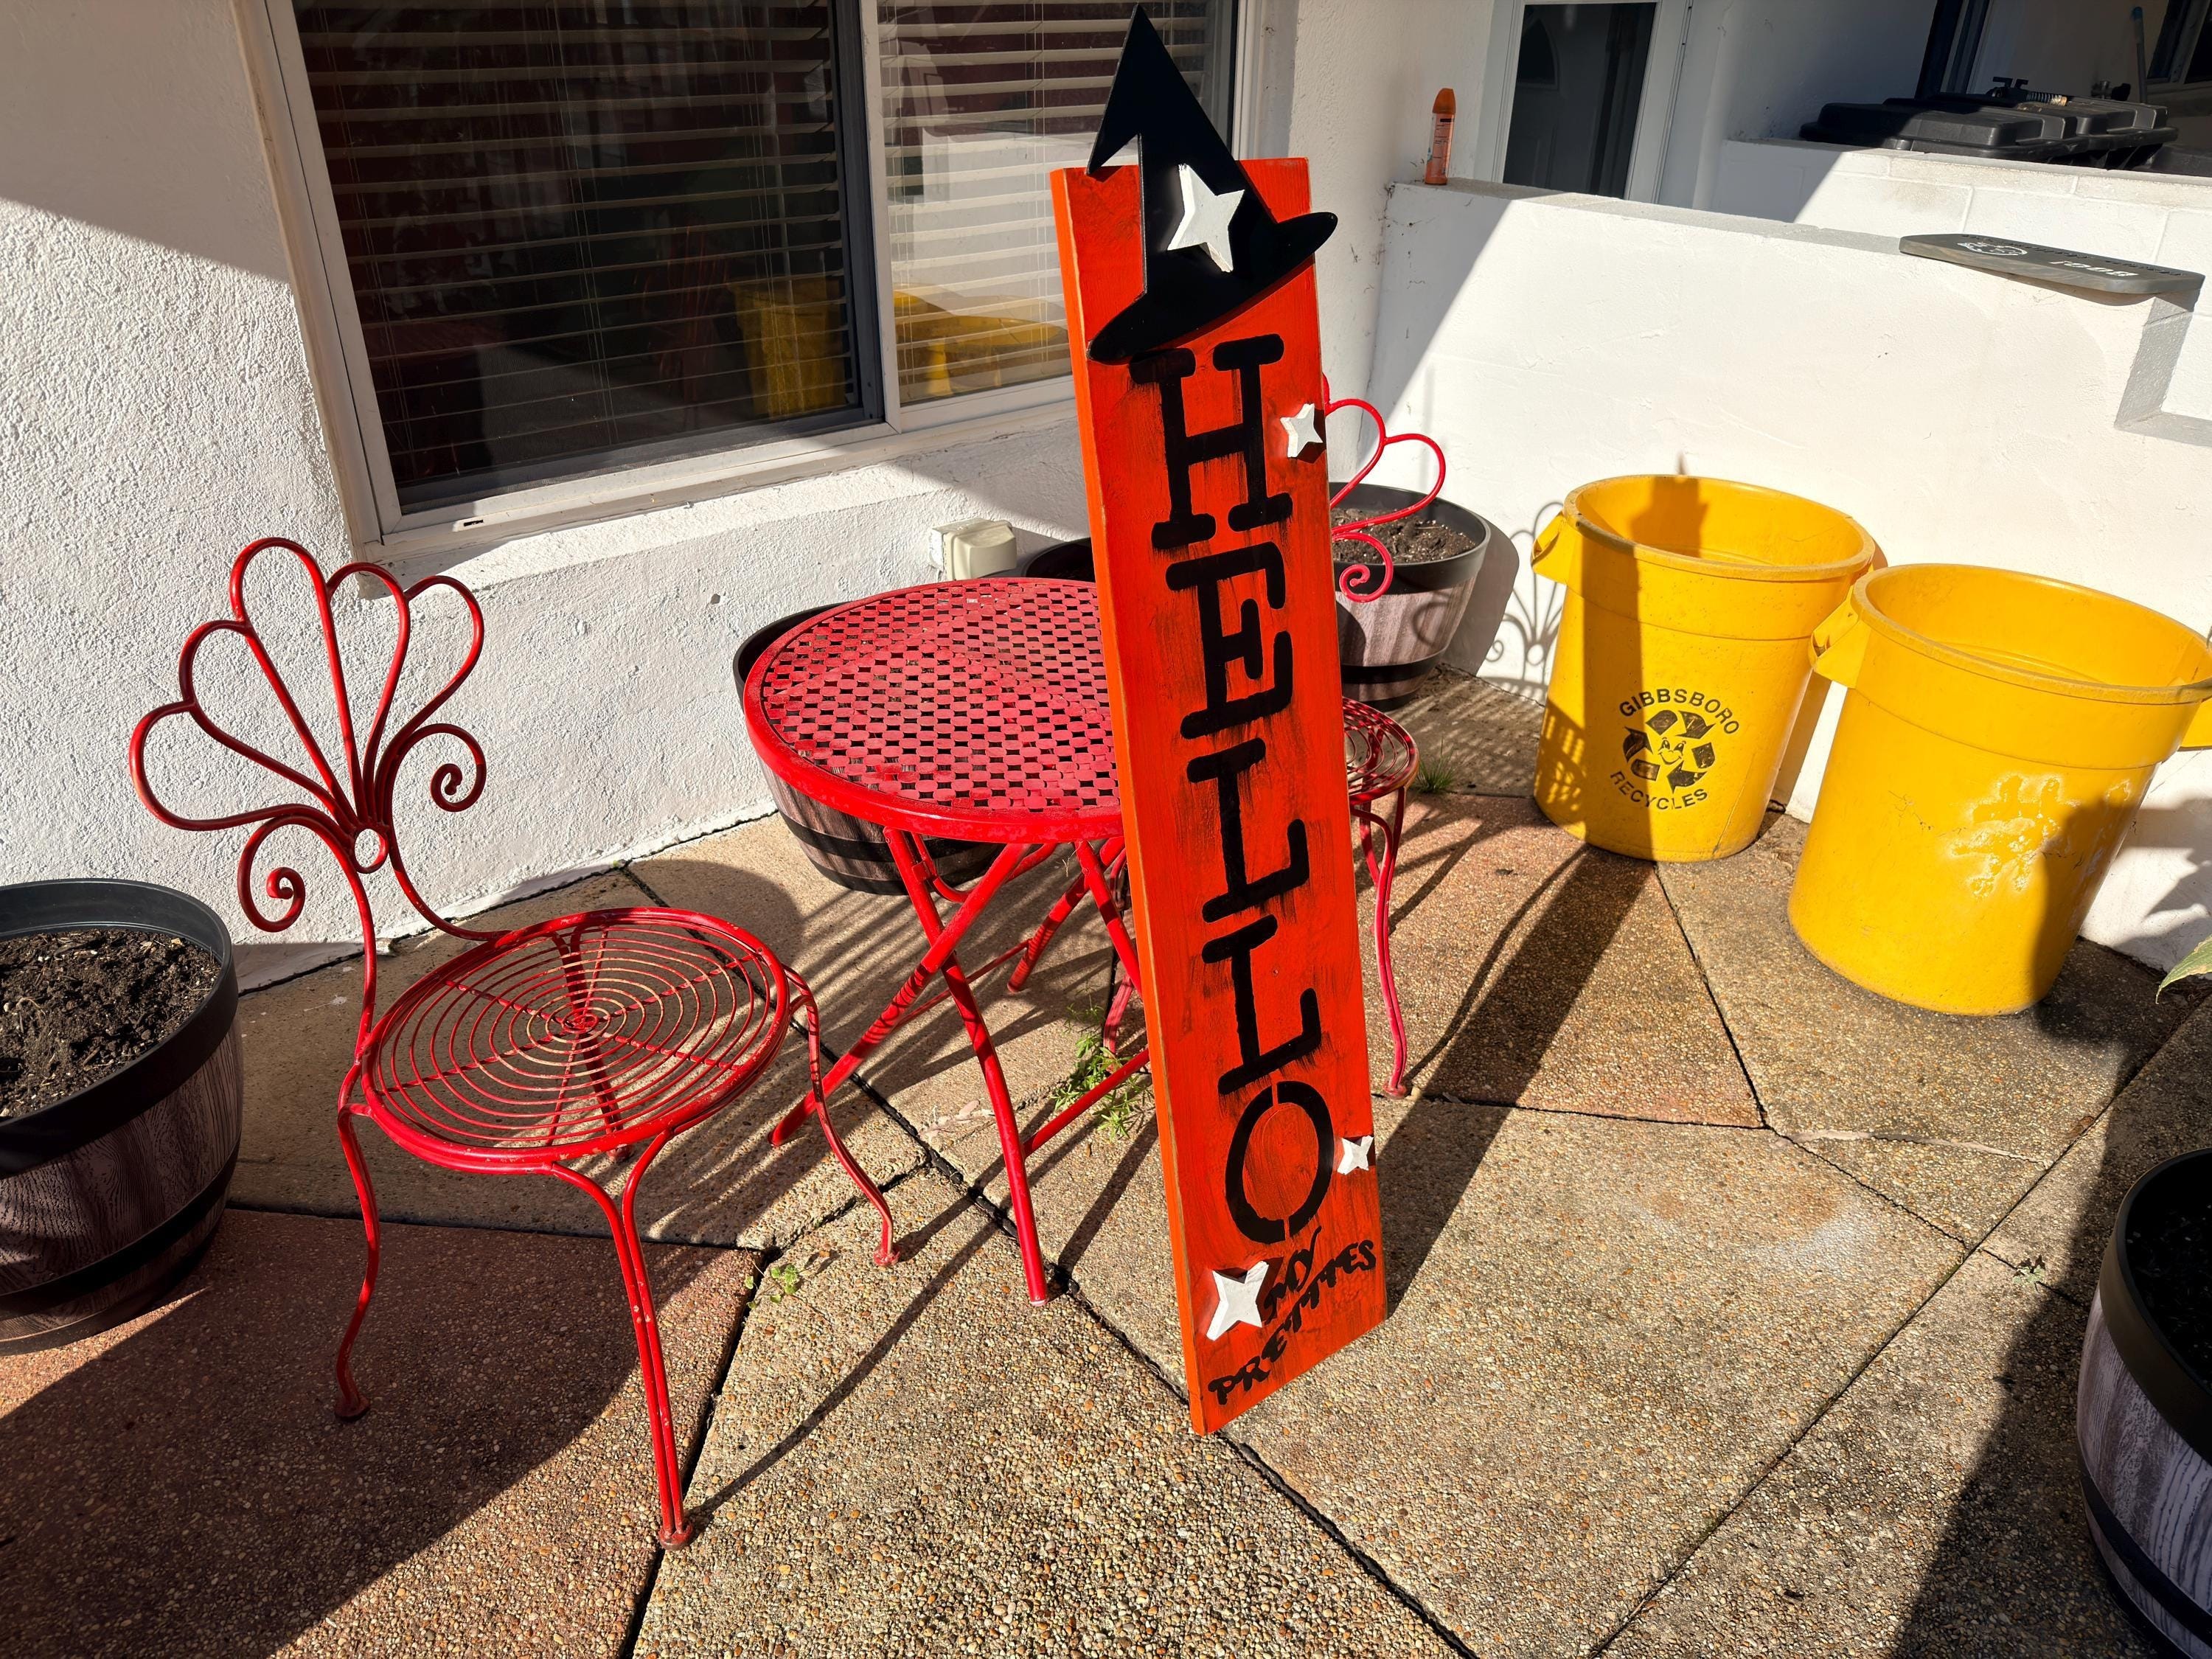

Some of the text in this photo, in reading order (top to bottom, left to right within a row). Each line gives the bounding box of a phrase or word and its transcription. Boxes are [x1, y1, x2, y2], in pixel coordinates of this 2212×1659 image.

[1618, 687, 1740, 735] GIBBSBORO
[1129, 333, 1334, 1243] HELLO
[1610, 771, 1708, 810] RECYCLES
[1207, 1239, 1377, 1405] PRETTIES
